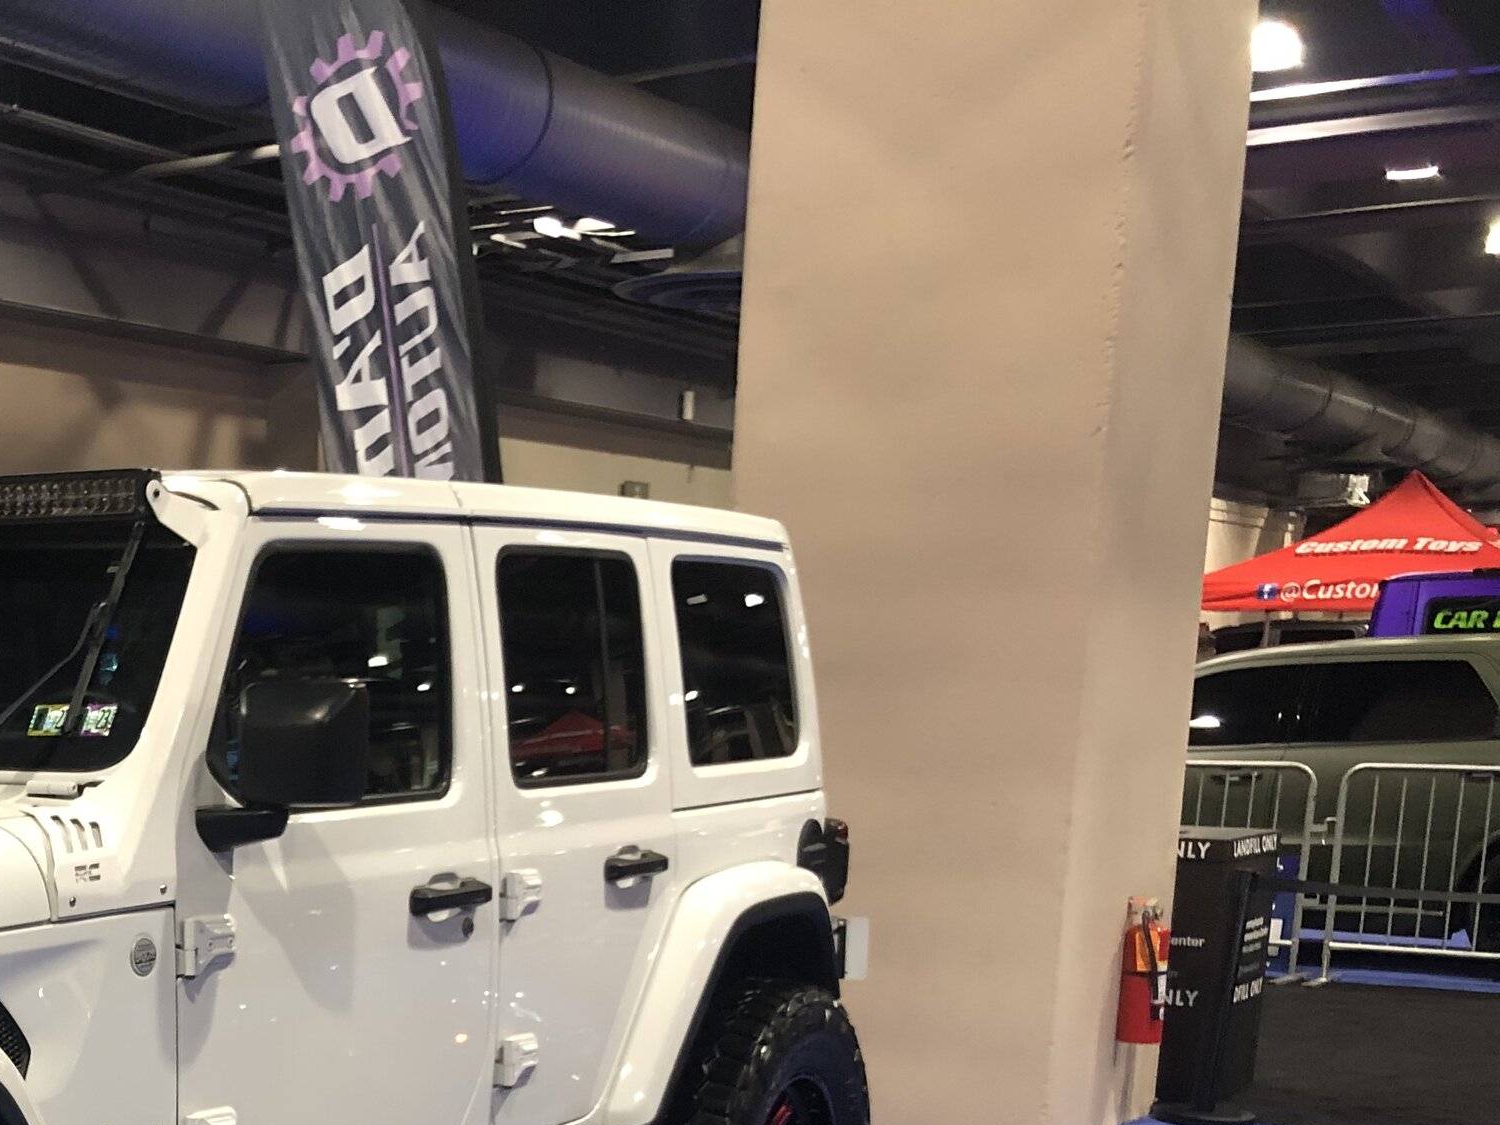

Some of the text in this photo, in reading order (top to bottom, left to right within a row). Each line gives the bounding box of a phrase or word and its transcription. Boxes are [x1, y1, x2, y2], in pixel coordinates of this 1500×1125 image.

[1295, 537, 1484, 555] Custom Toys
[1433, 609, 1489, 629] CAR
